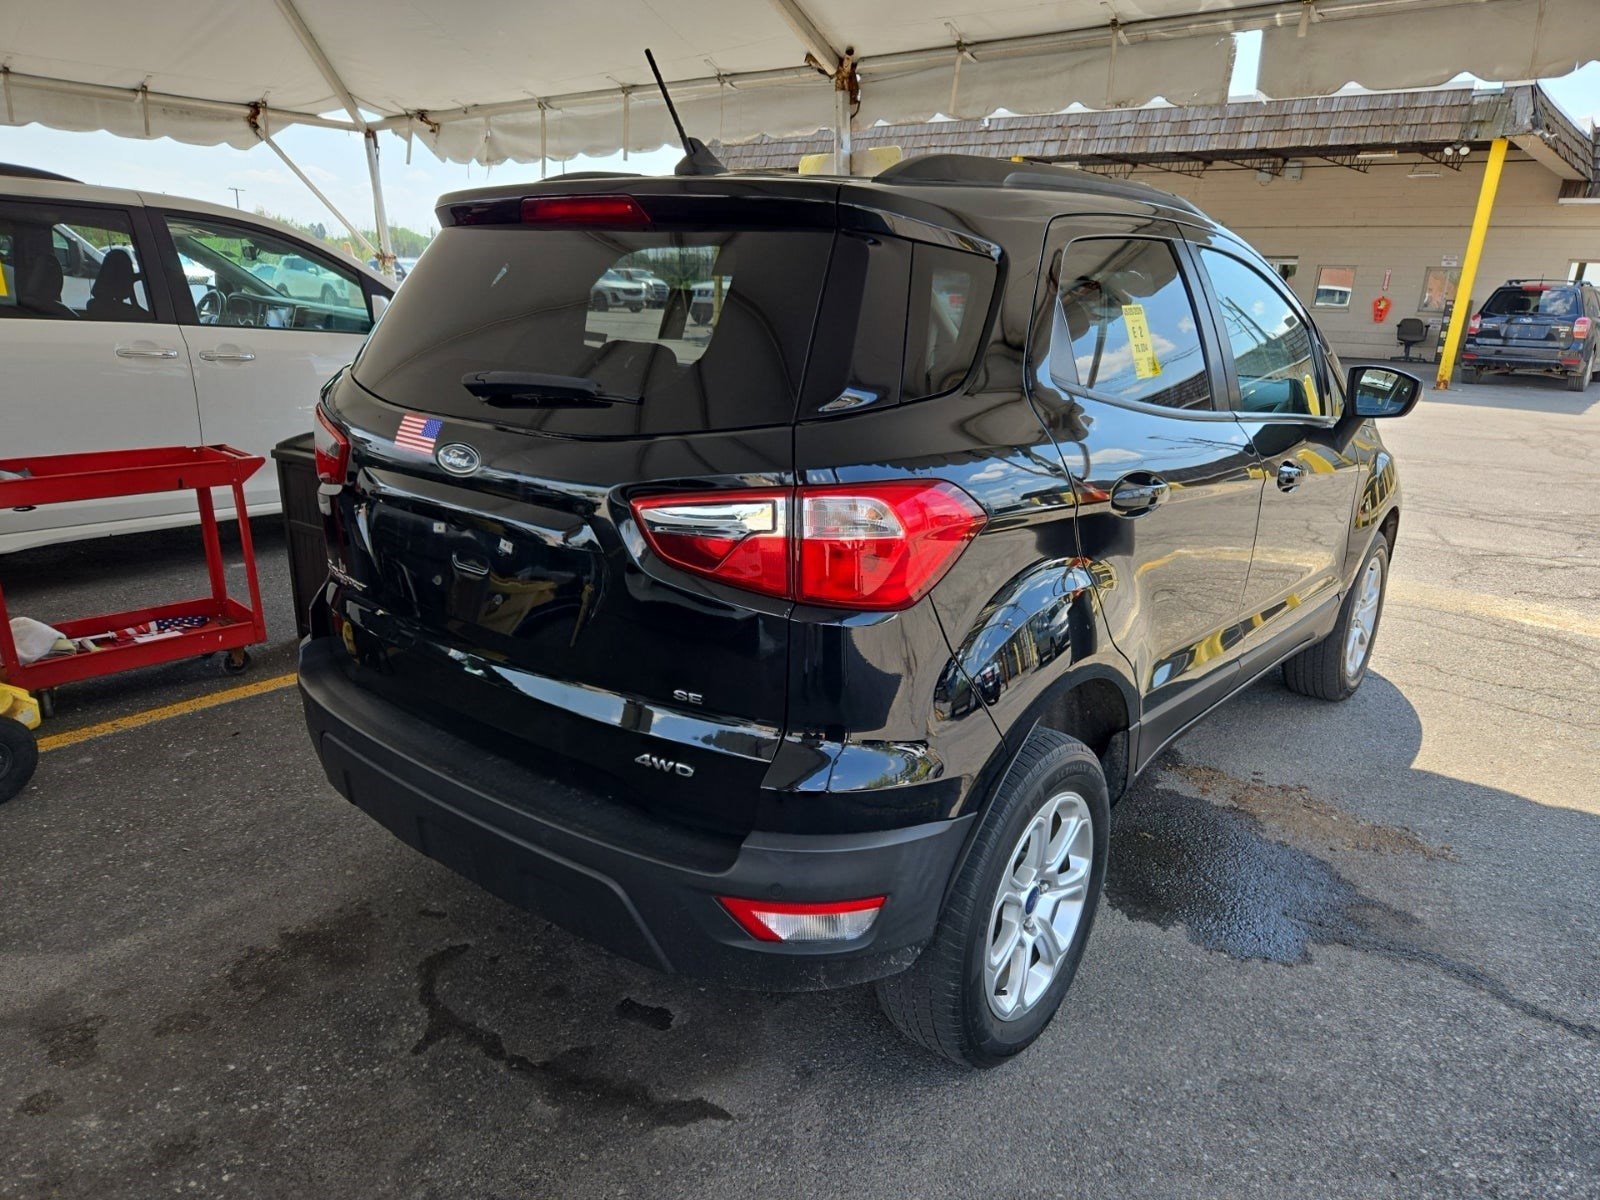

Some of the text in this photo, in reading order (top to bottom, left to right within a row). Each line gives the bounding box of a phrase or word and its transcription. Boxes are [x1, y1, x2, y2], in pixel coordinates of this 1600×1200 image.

[444, 449, 470, 468] Ford
[673, 689, 703, 705] SE
[634, 753, 695, 777] 4WD
